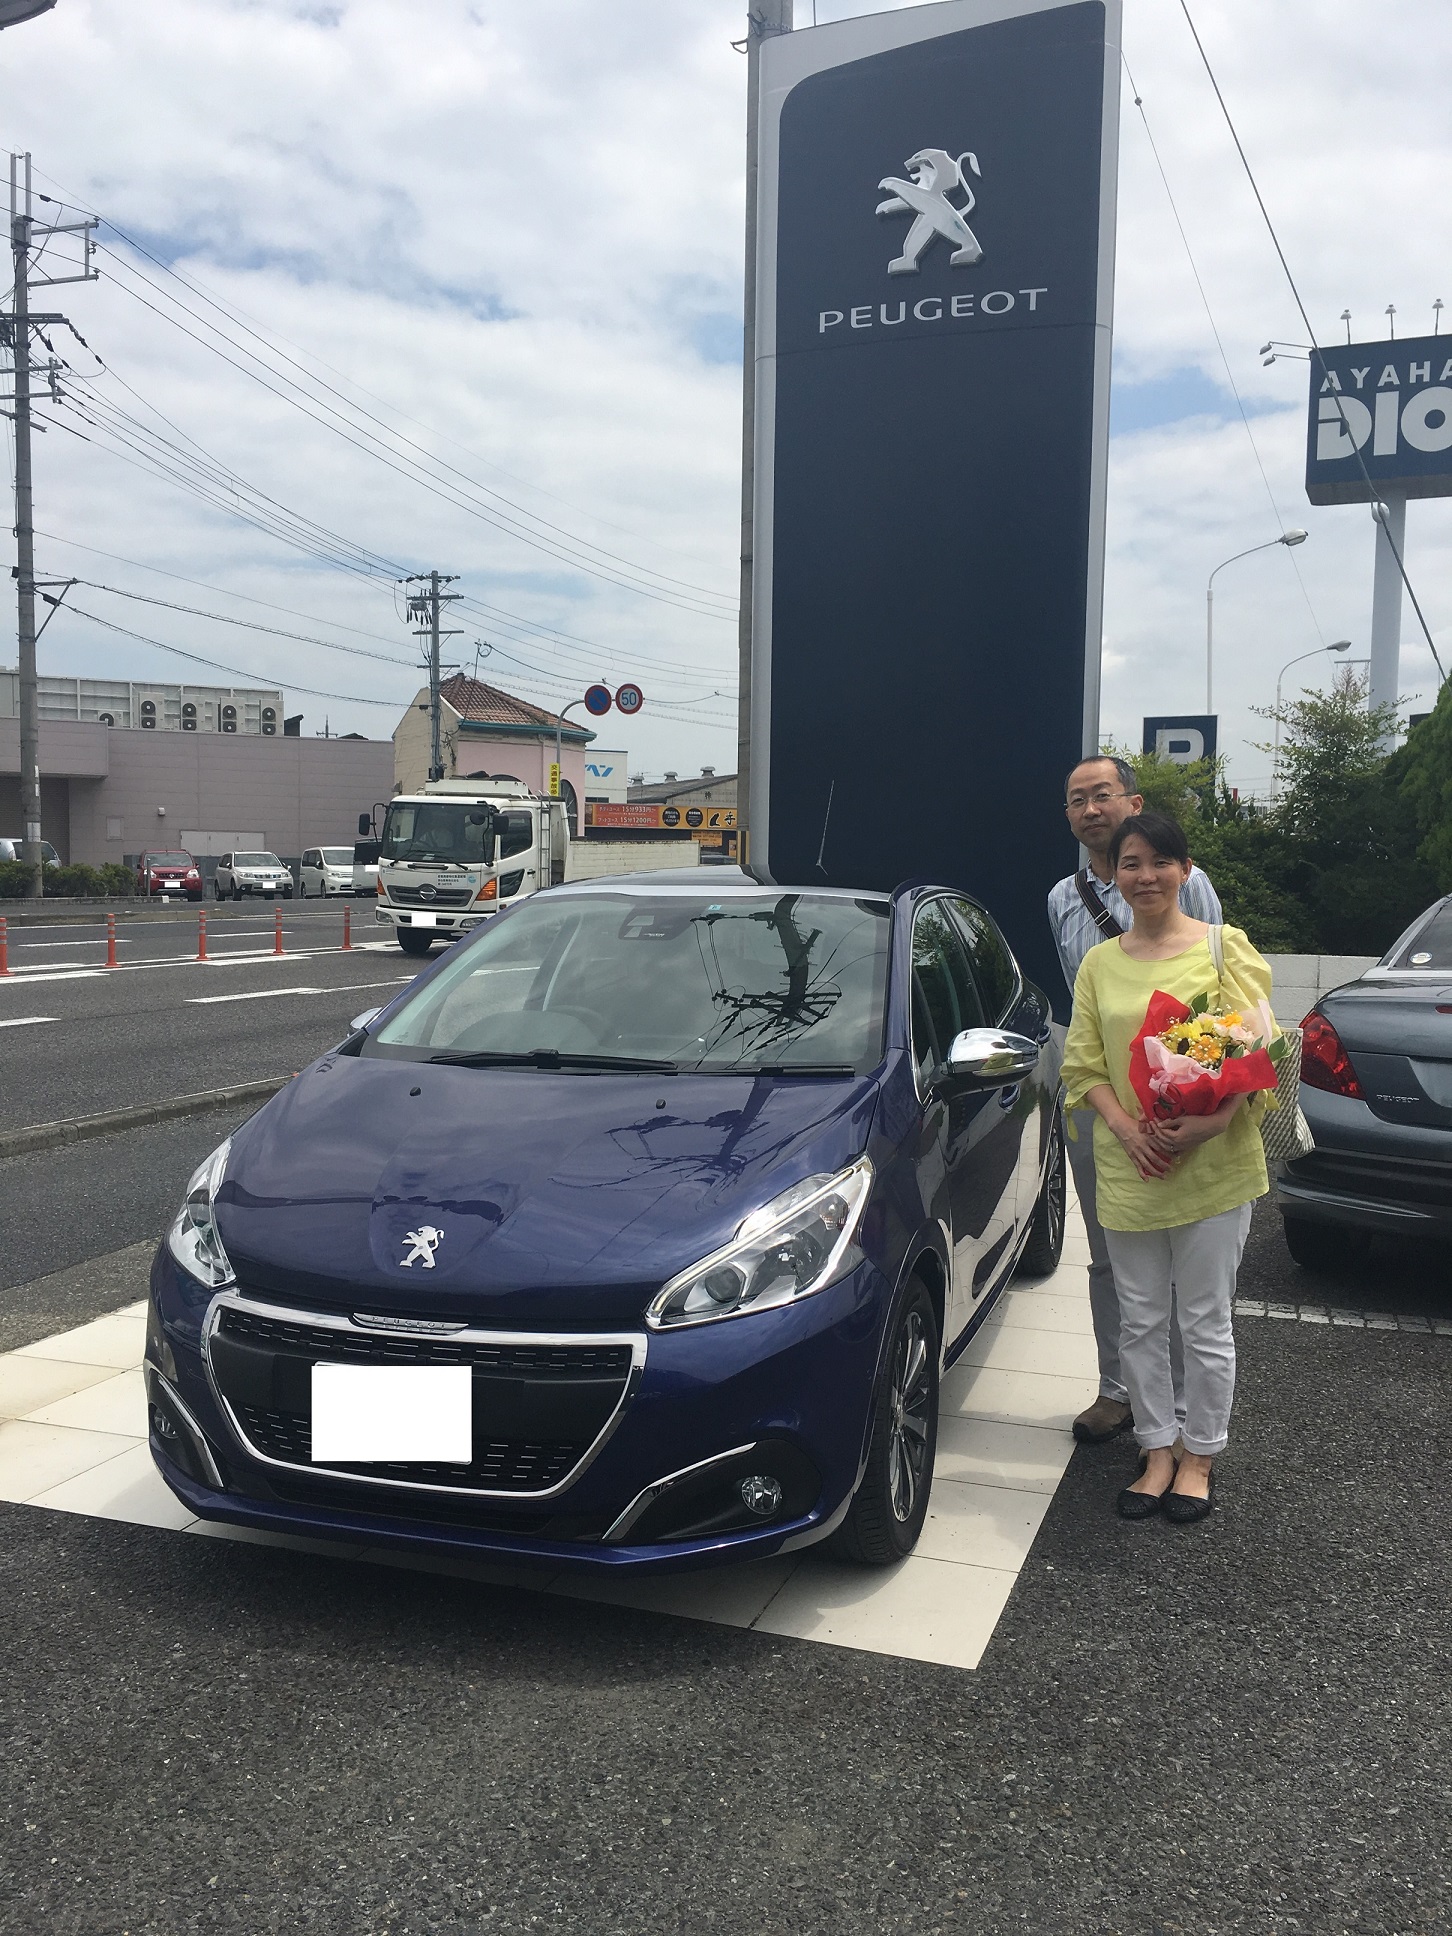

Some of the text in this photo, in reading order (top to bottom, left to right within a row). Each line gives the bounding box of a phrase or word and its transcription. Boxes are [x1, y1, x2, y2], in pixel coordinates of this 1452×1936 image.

[819, 287, 1048, 333] PEUGEOT
[1320, 358, 1452, 392] AYAHA
[1317, 386, 1452, 460] DIO
[621, 692, 637, 706] 50
[1155, 728, 1205, 765] P
